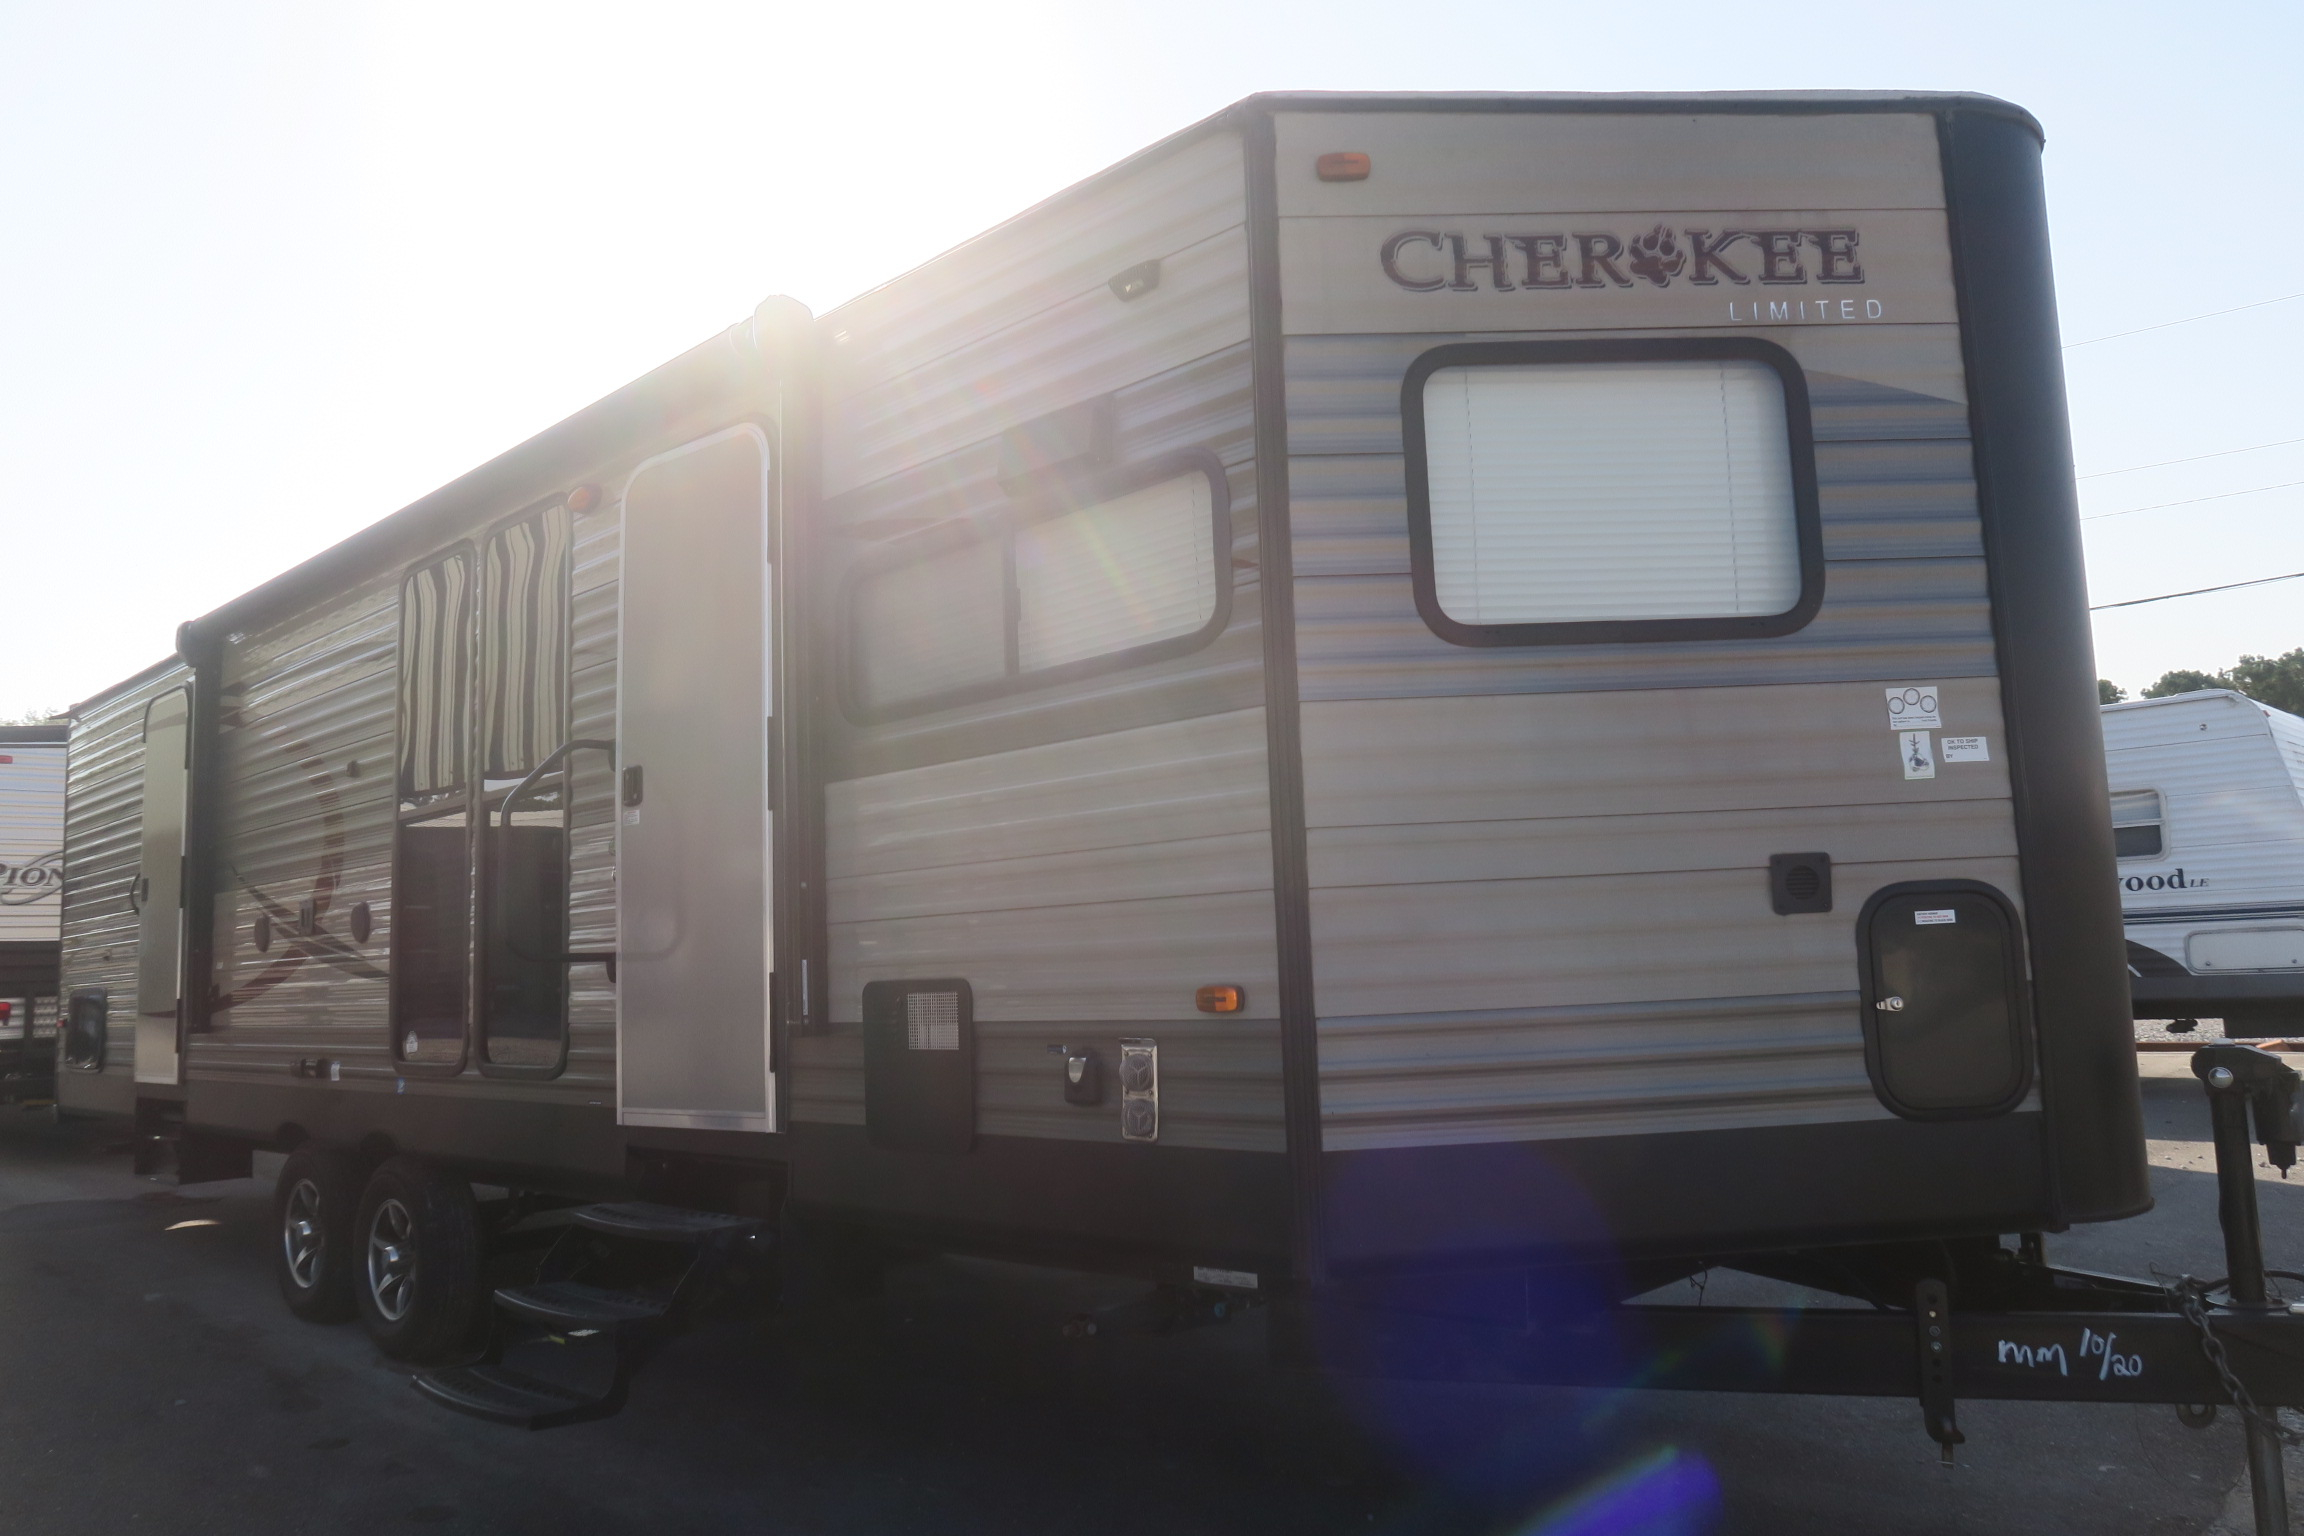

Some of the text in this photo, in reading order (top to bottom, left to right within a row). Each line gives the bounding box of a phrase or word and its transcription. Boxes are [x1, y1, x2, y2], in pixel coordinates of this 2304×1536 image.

[1729, 299, 1882, 321] LIMITED
[2118, 868, 2209, 891] ood LE
[2079, 1327, 2142, 1380] 10/20
